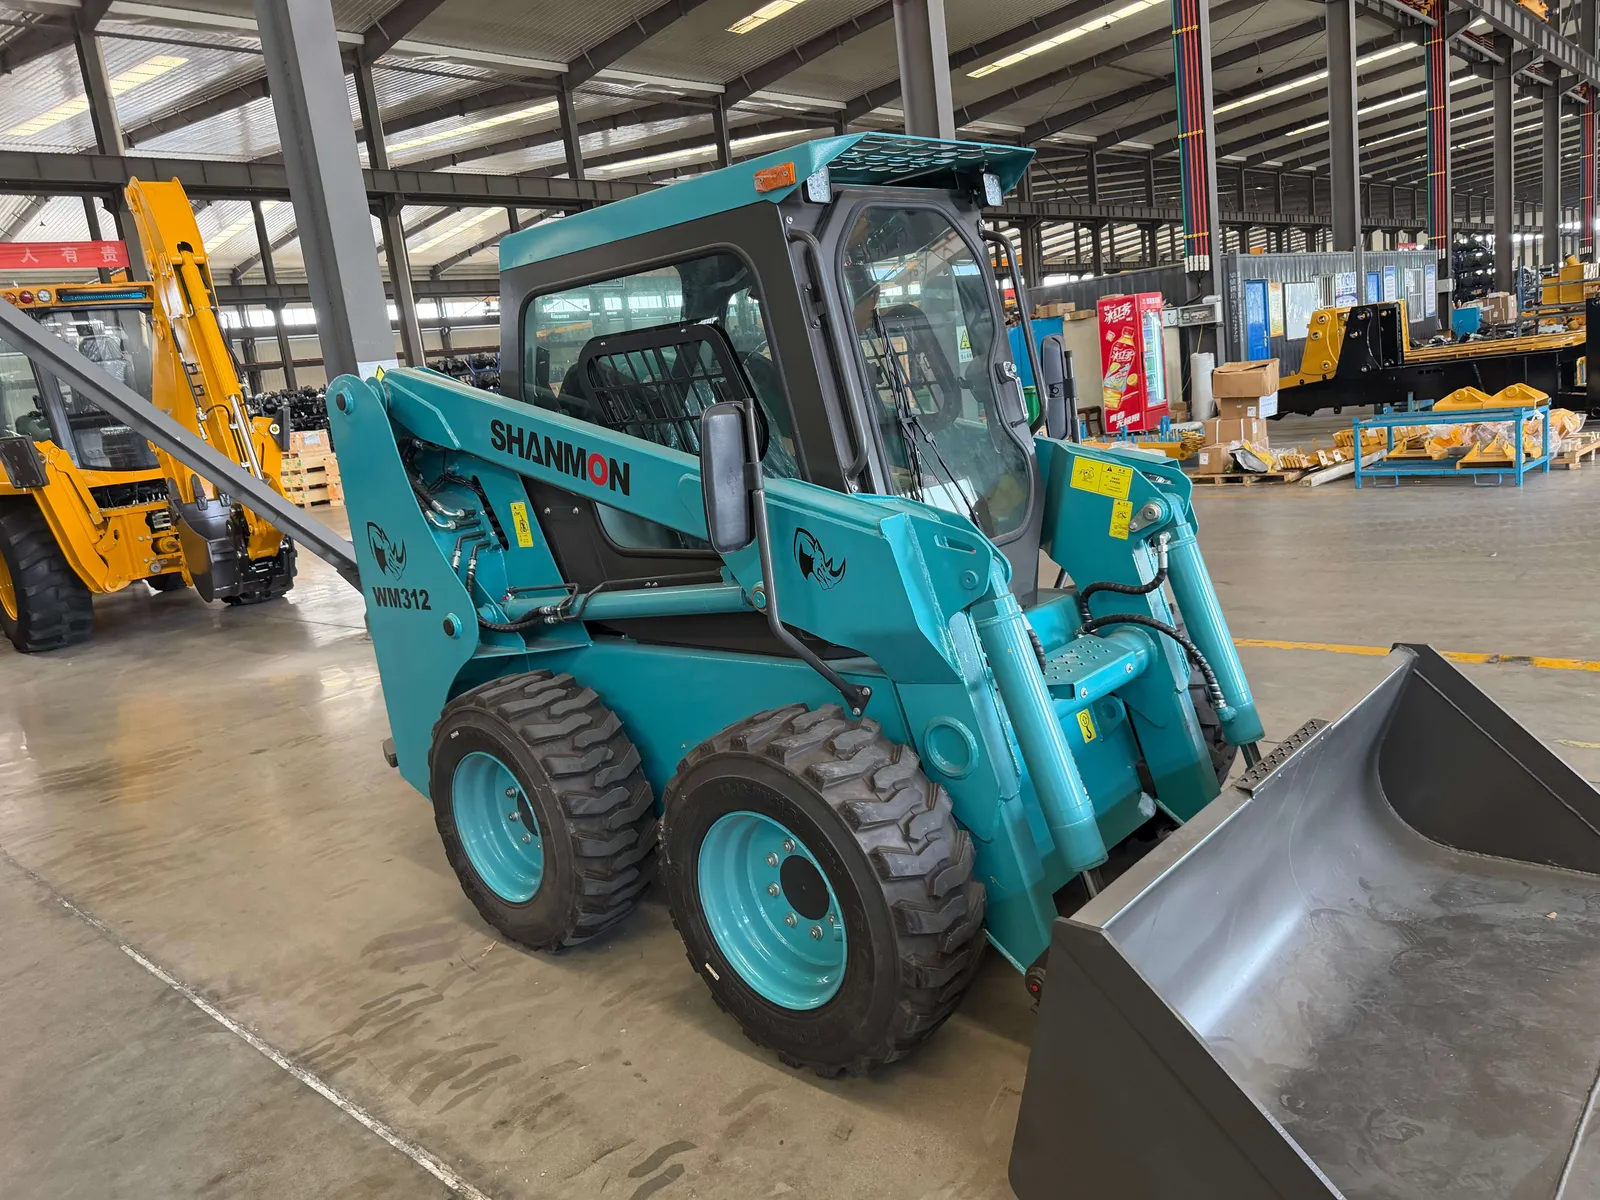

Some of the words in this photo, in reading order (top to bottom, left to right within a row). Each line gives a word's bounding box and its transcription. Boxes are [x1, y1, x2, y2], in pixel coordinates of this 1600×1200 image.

[20, 245, 118, 263] 人有责
[490, 419, 630, 496] SHANMON
[372, 586, 432, 611] WM312
